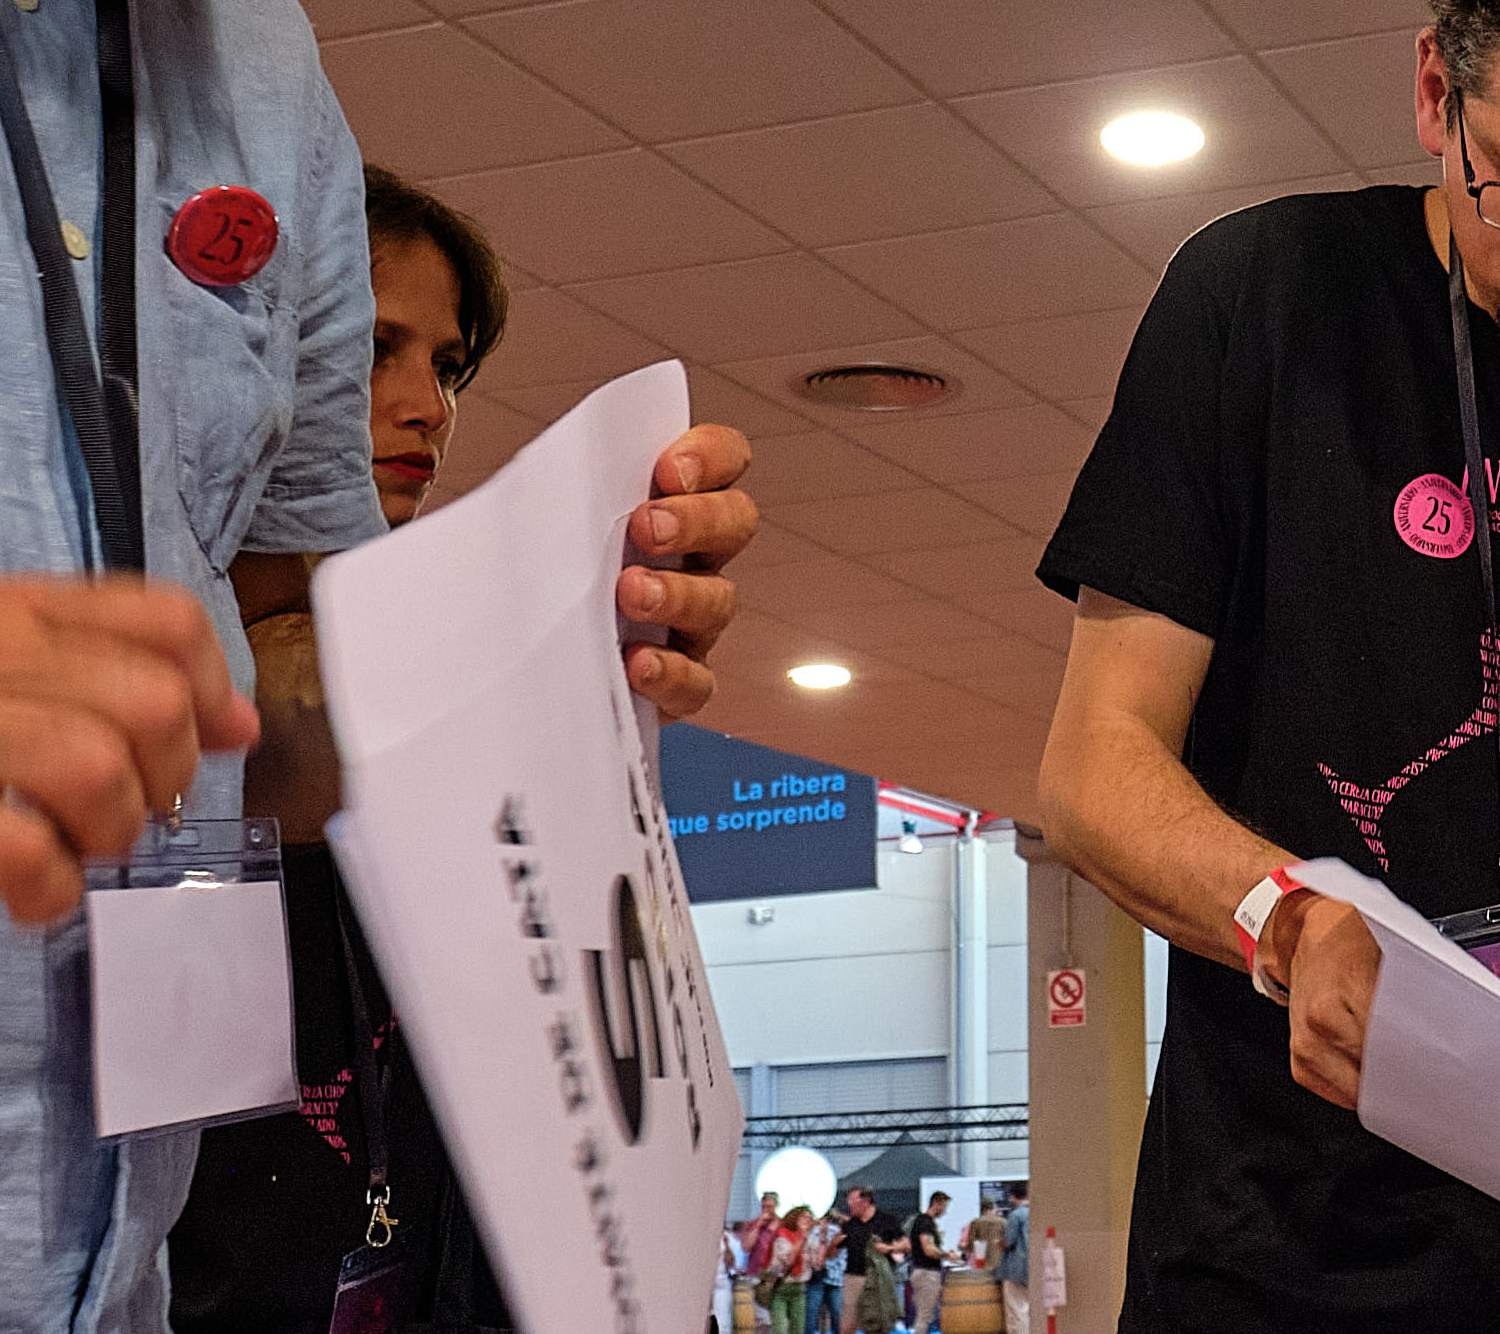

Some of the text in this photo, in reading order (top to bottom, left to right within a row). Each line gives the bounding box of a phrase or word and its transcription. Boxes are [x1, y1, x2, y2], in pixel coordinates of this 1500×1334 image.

[199, 211, 255, 266] 25
[1422, 496, 1452, 535] 25
[733, 772, 846, 802] La ribera
[668, 798, 846, 839] que sorprende
[580, 873, 667, 1148] S
